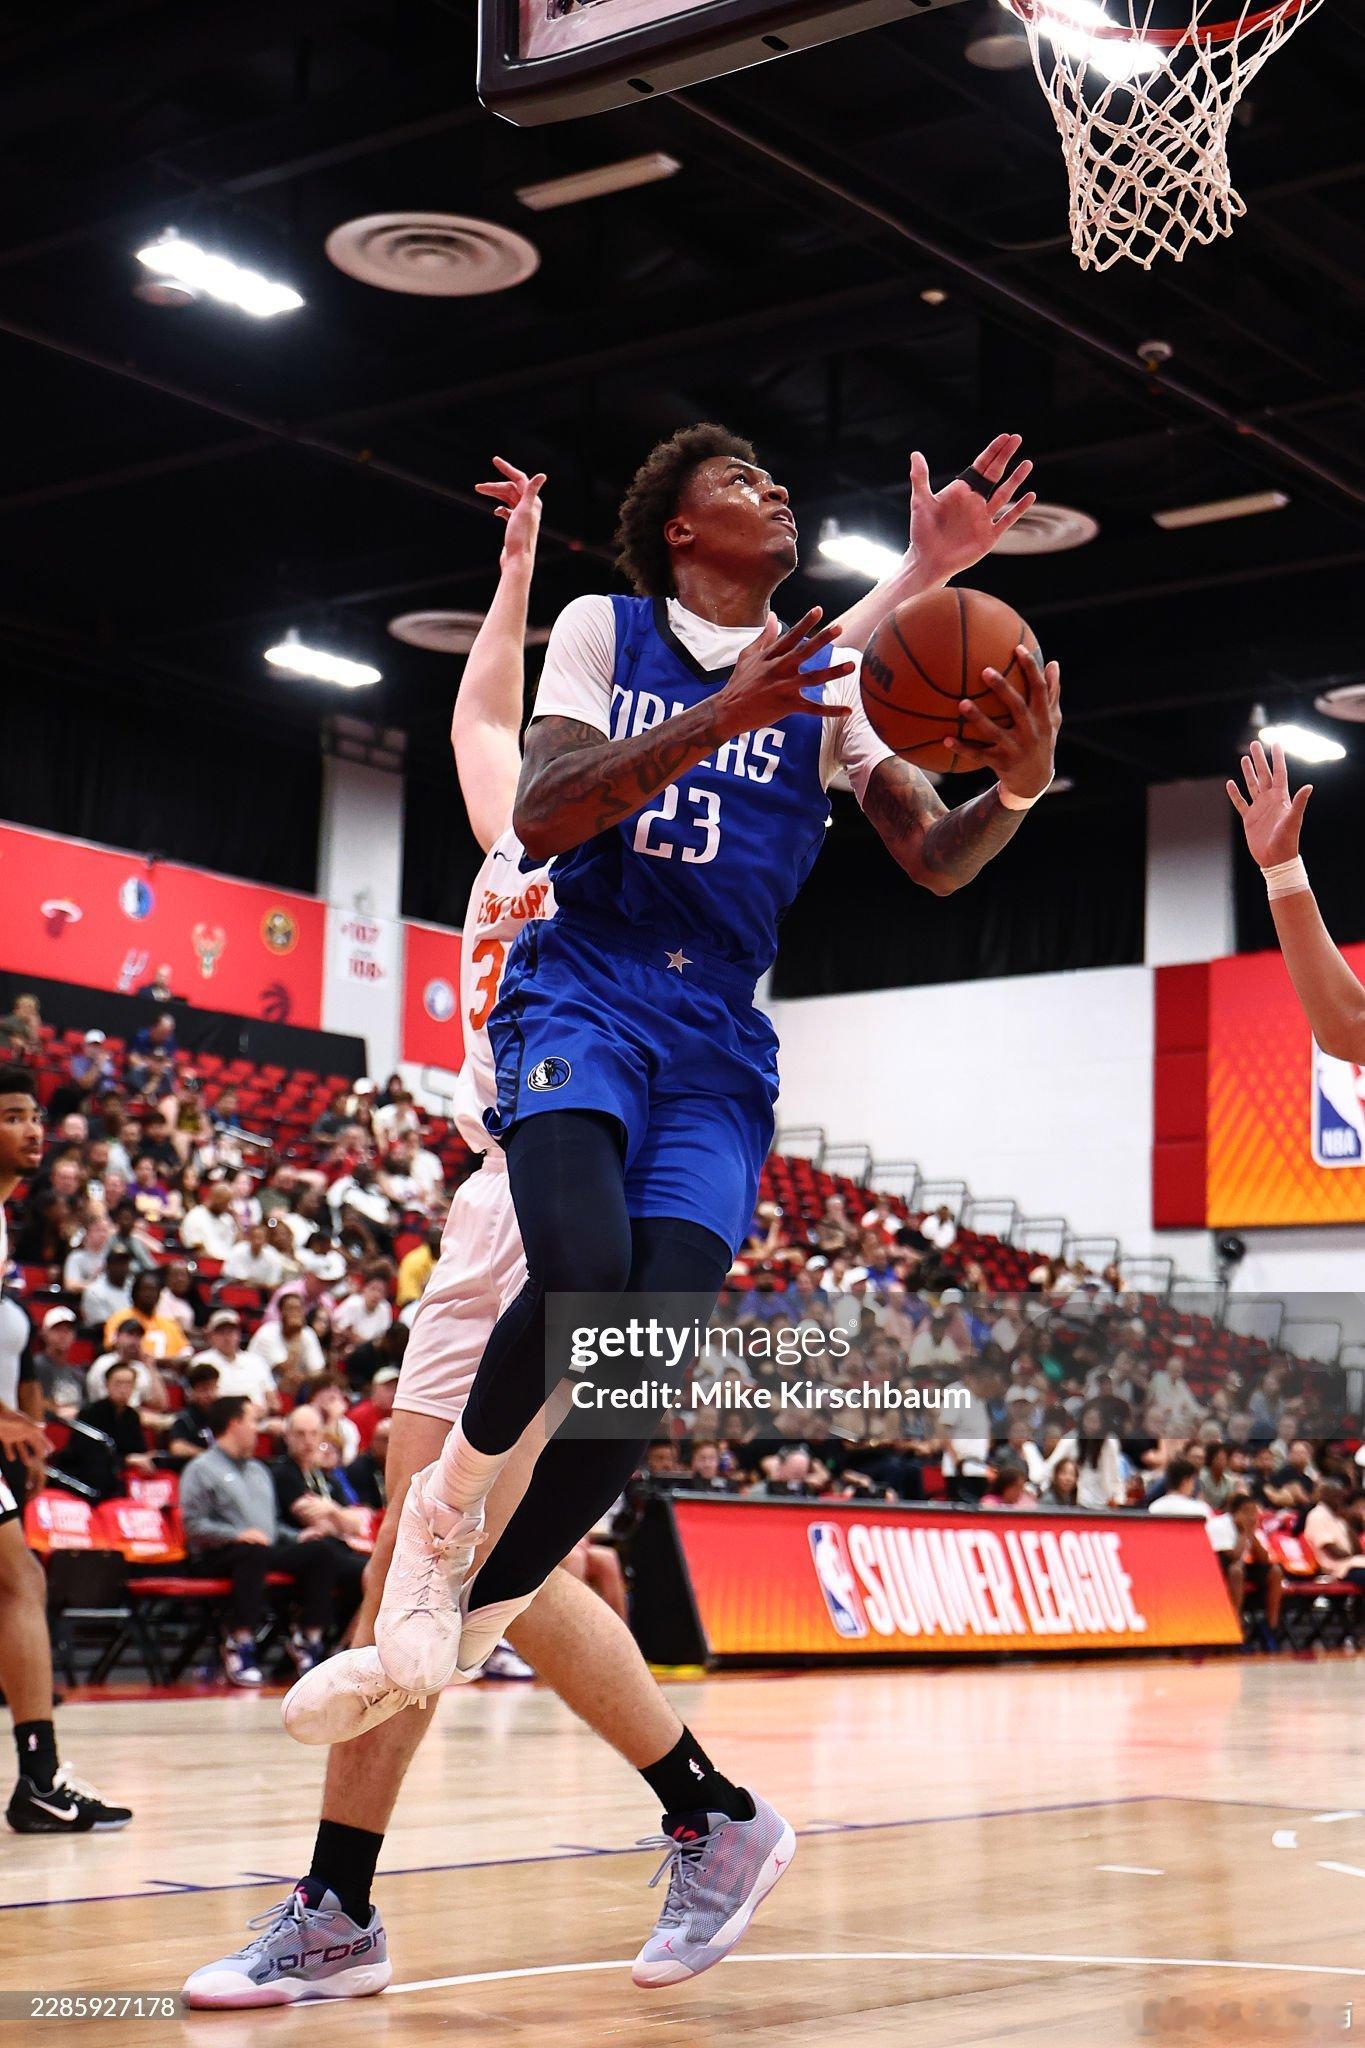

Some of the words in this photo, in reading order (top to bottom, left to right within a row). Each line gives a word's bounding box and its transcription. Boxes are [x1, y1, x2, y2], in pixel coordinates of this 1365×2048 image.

[633, 784, 721, 864] 23
[848, 1524, 1027, 1636] SUMMER
[1004, 1530, 1147, 1635] LEAGUE
